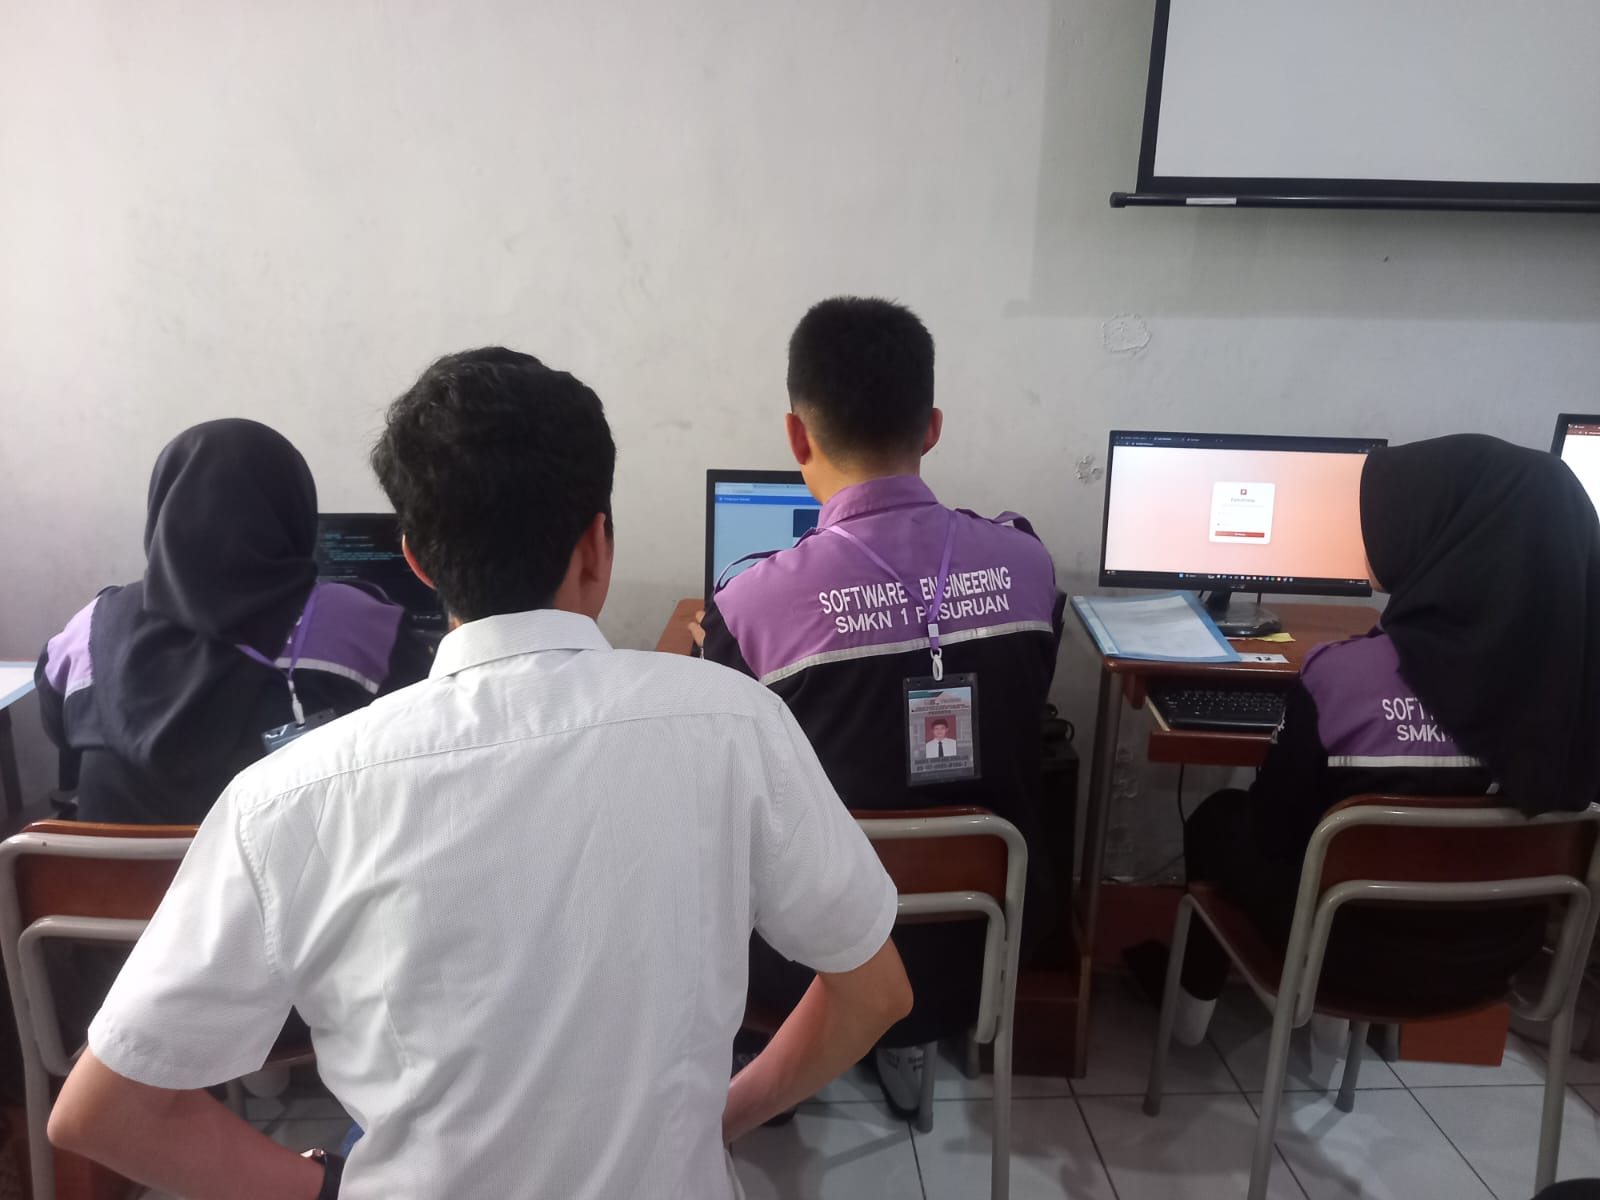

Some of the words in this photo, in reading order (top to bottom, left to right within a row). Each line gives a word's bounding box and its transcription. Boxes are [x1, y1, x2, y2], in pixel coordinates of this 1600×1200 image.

[818, 582, 908, 614] SOFTWARE
[835, 610, 893, 634] SMKN
[900, 610, 909, 625] 1
[915, 594, 1010, 624] PSURUAN
